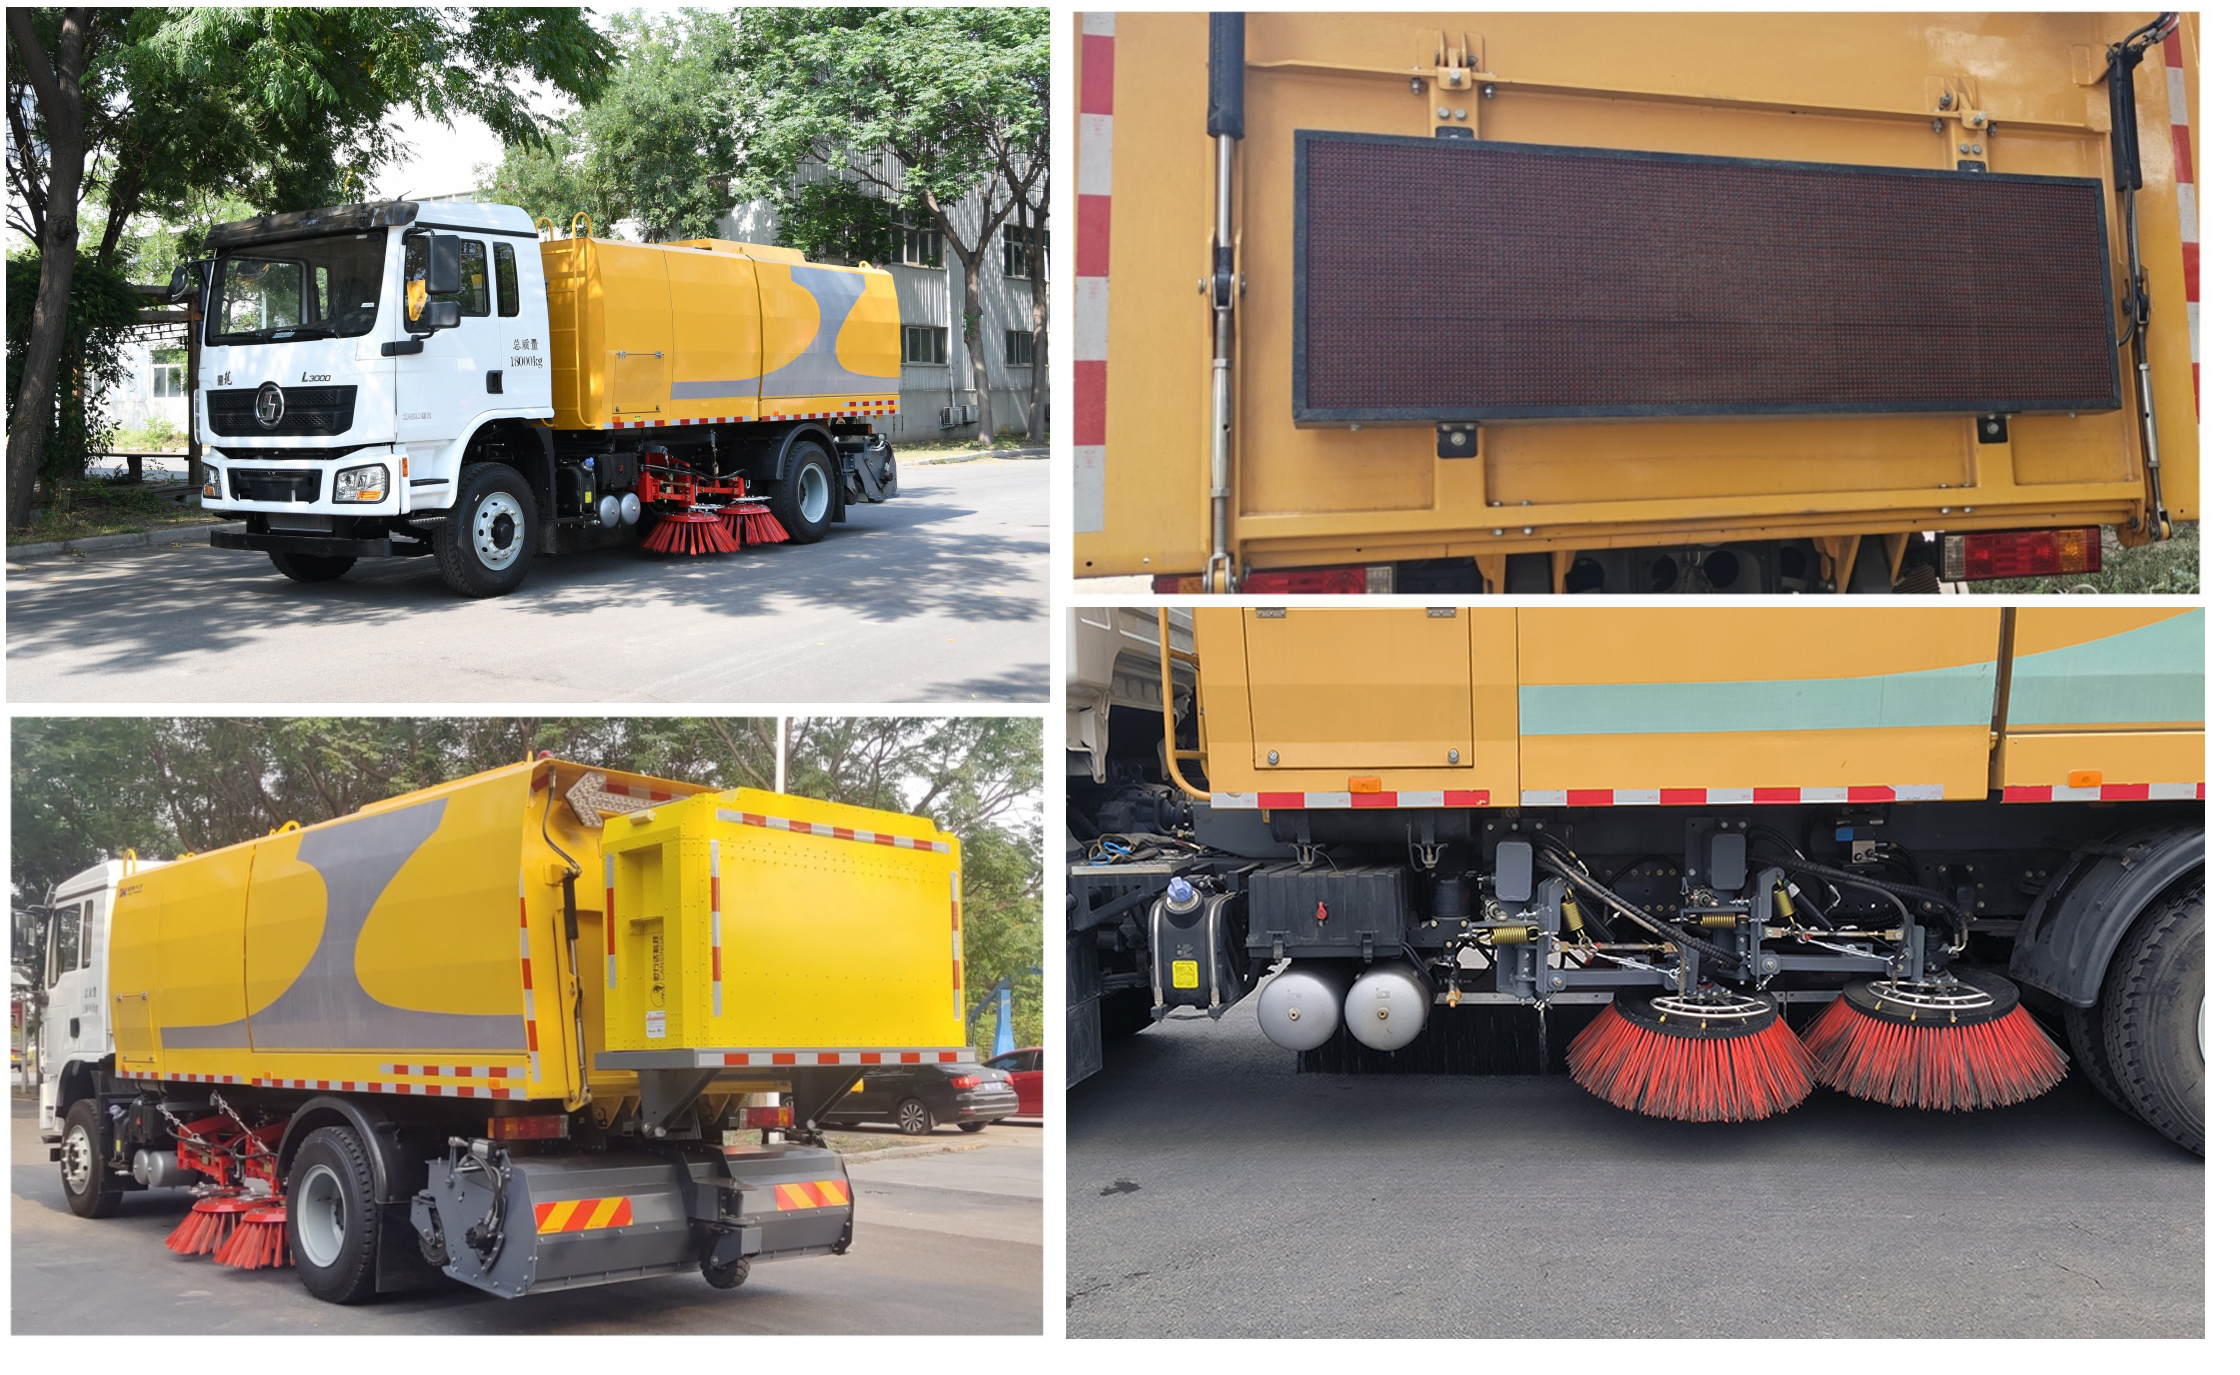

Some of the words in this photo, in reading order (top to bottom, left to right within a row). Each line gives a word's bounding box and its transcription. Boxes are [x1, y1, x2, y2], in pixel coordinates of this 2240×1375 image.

[512, 338, 539, 351] 总质量
[510, 355, 543, 369] 18000kg
[301, 371, 331, 382] L3000
